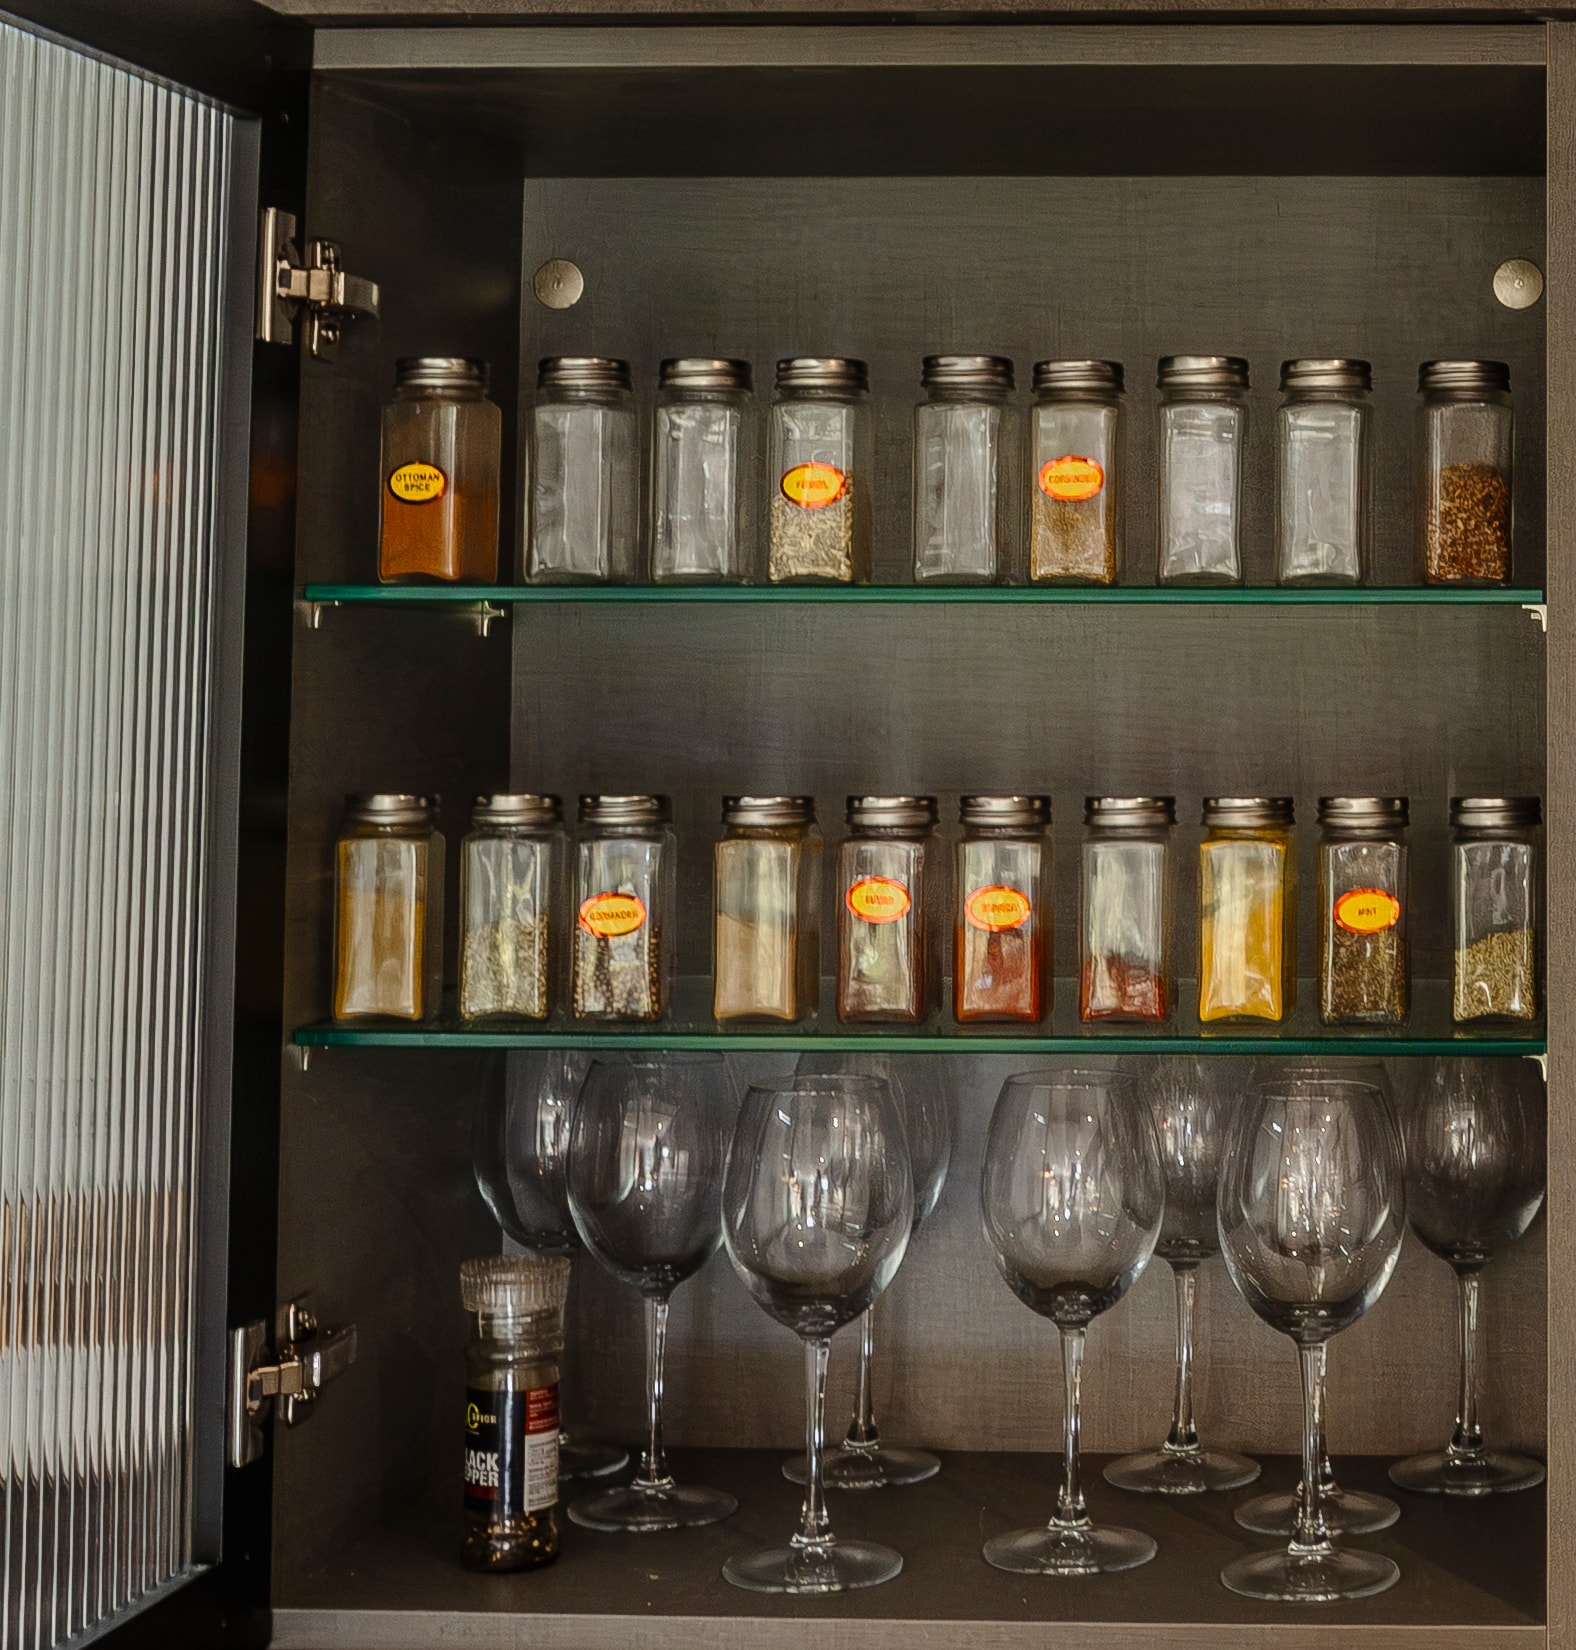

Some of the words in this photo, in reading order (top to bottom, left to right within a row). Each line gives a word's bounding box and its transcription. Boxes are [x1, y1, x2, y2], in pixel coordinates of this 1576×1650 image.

[395, 472, 440, 482] OTTOMAN
[404, 483, 431, 492] SPICE
[465, 1447, 500, 1472] LACK
[464, 1466, 500, 1488] EPPER
